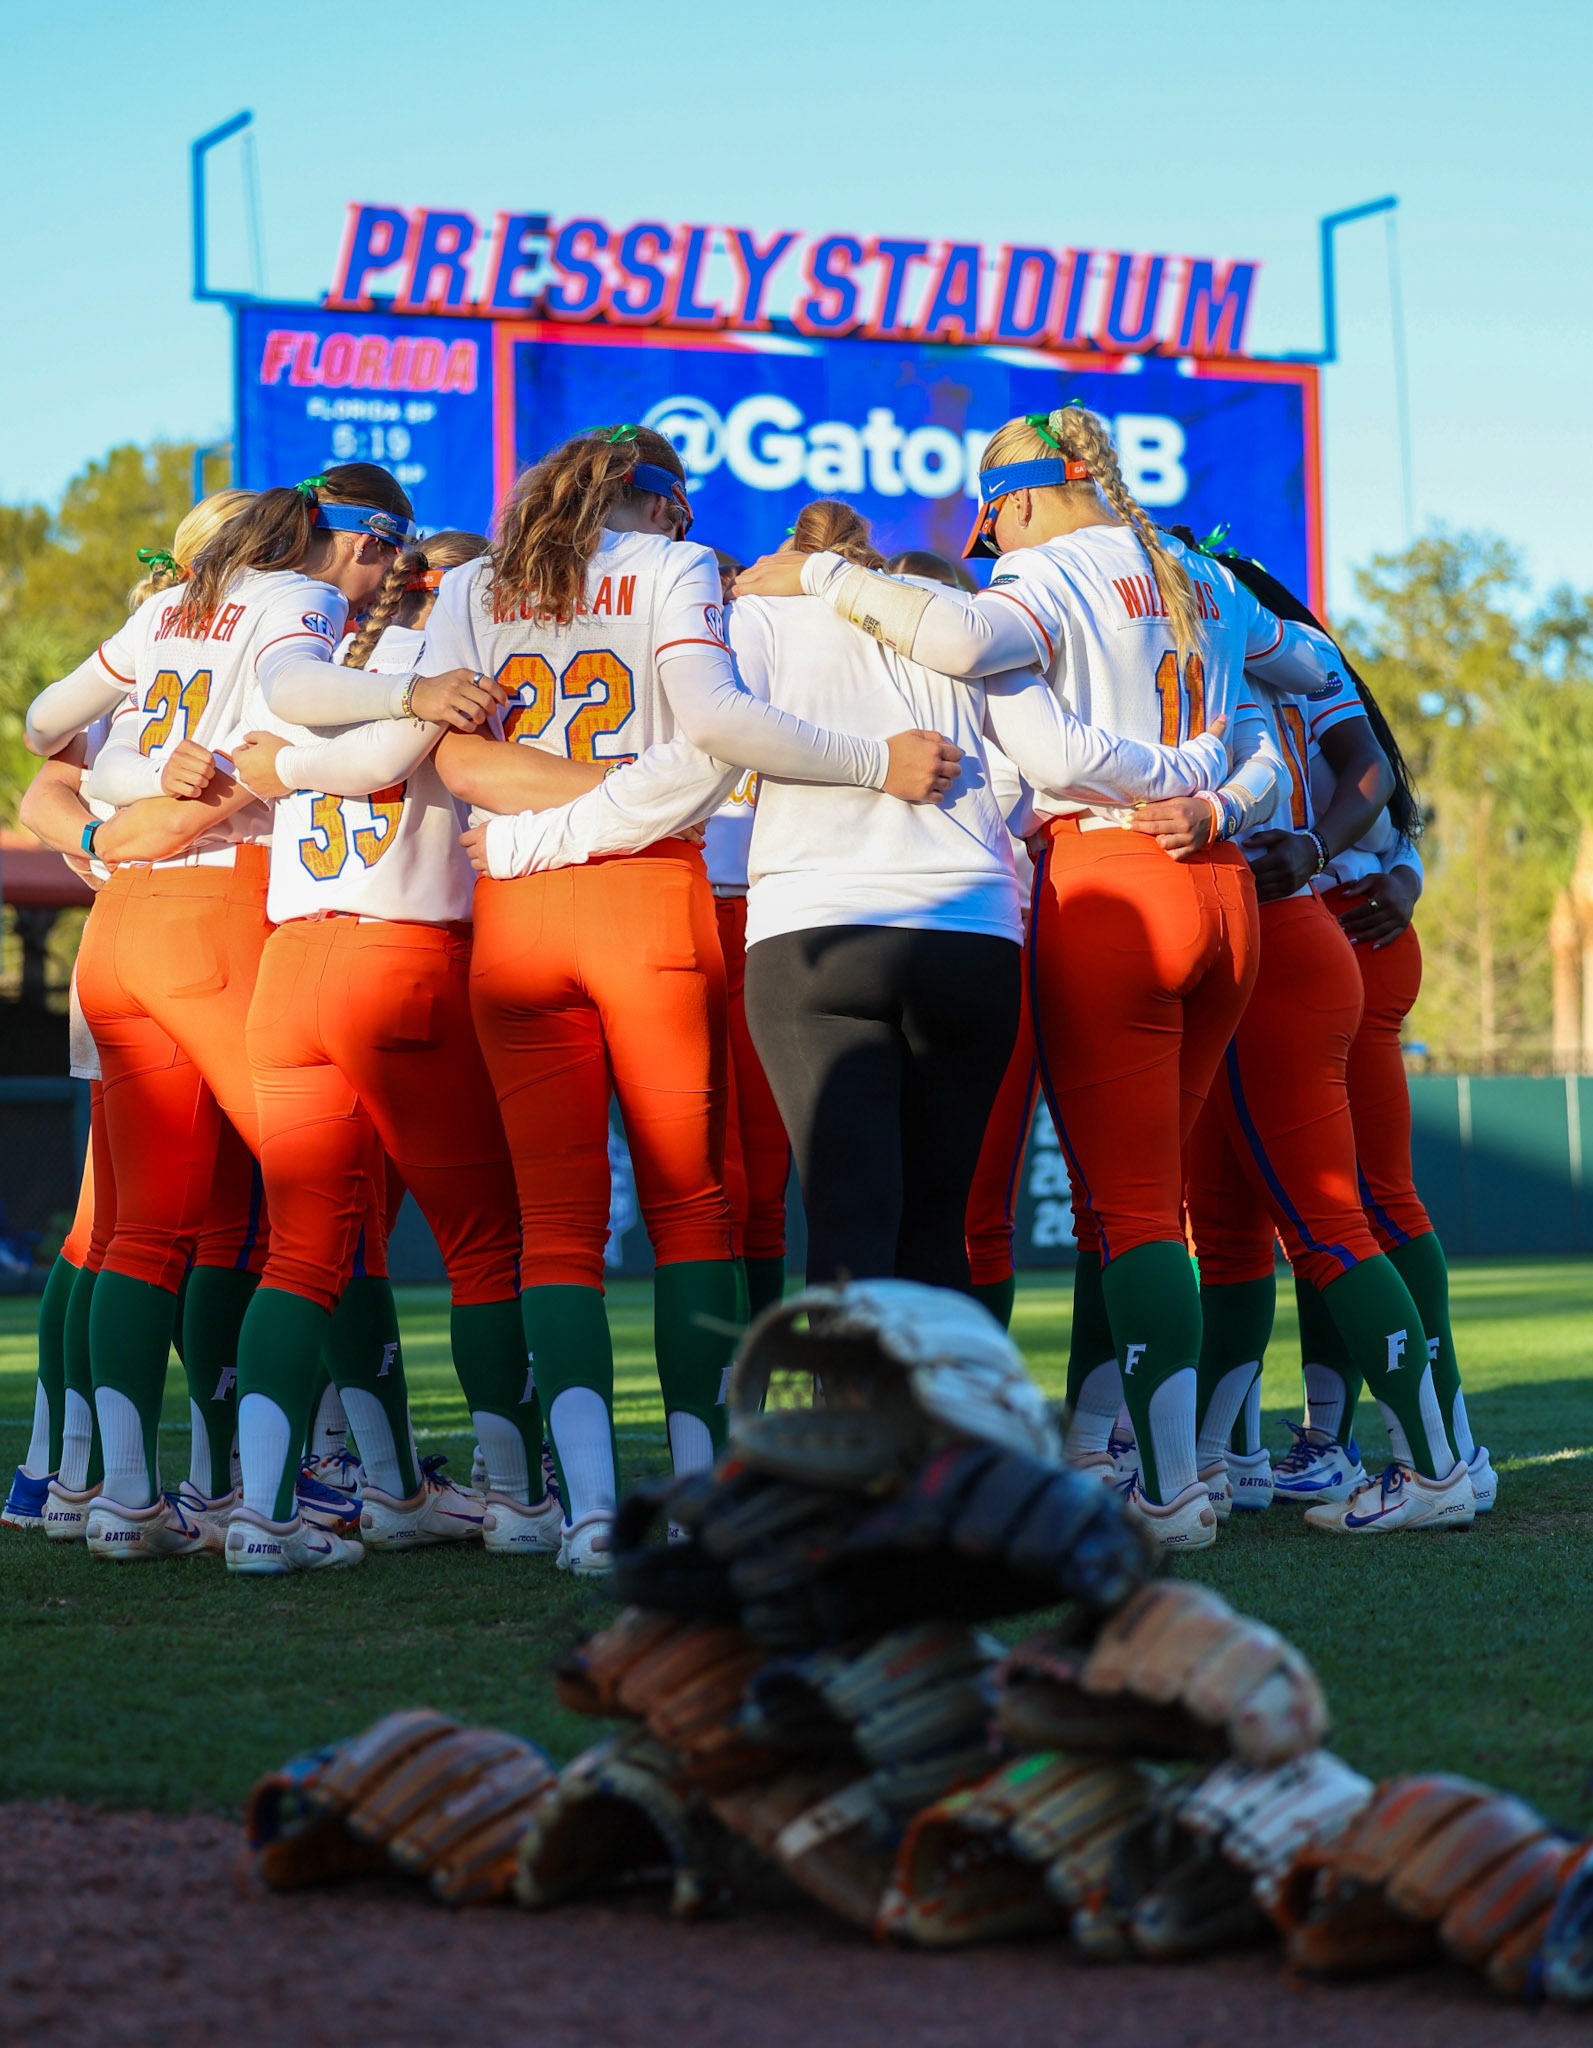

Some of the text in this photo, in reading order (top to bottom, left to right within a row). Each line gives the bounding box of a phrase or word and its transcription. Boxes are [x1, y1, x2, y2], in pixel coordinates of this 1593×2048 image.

[325, 203, 1261, 358] PRESSLY STADIUM
[260, 330, 479, 394] FLORIDA
[139, 669, 213, 757] 21
[494, 649, 639, 767] 22
[1155, 650, 1207, 748] 11
[47, 1512, 82, 1522] GATORS
[105, 1531, 141, 1542] GATORS
[247, 1543, 282, 1555] GATORS
